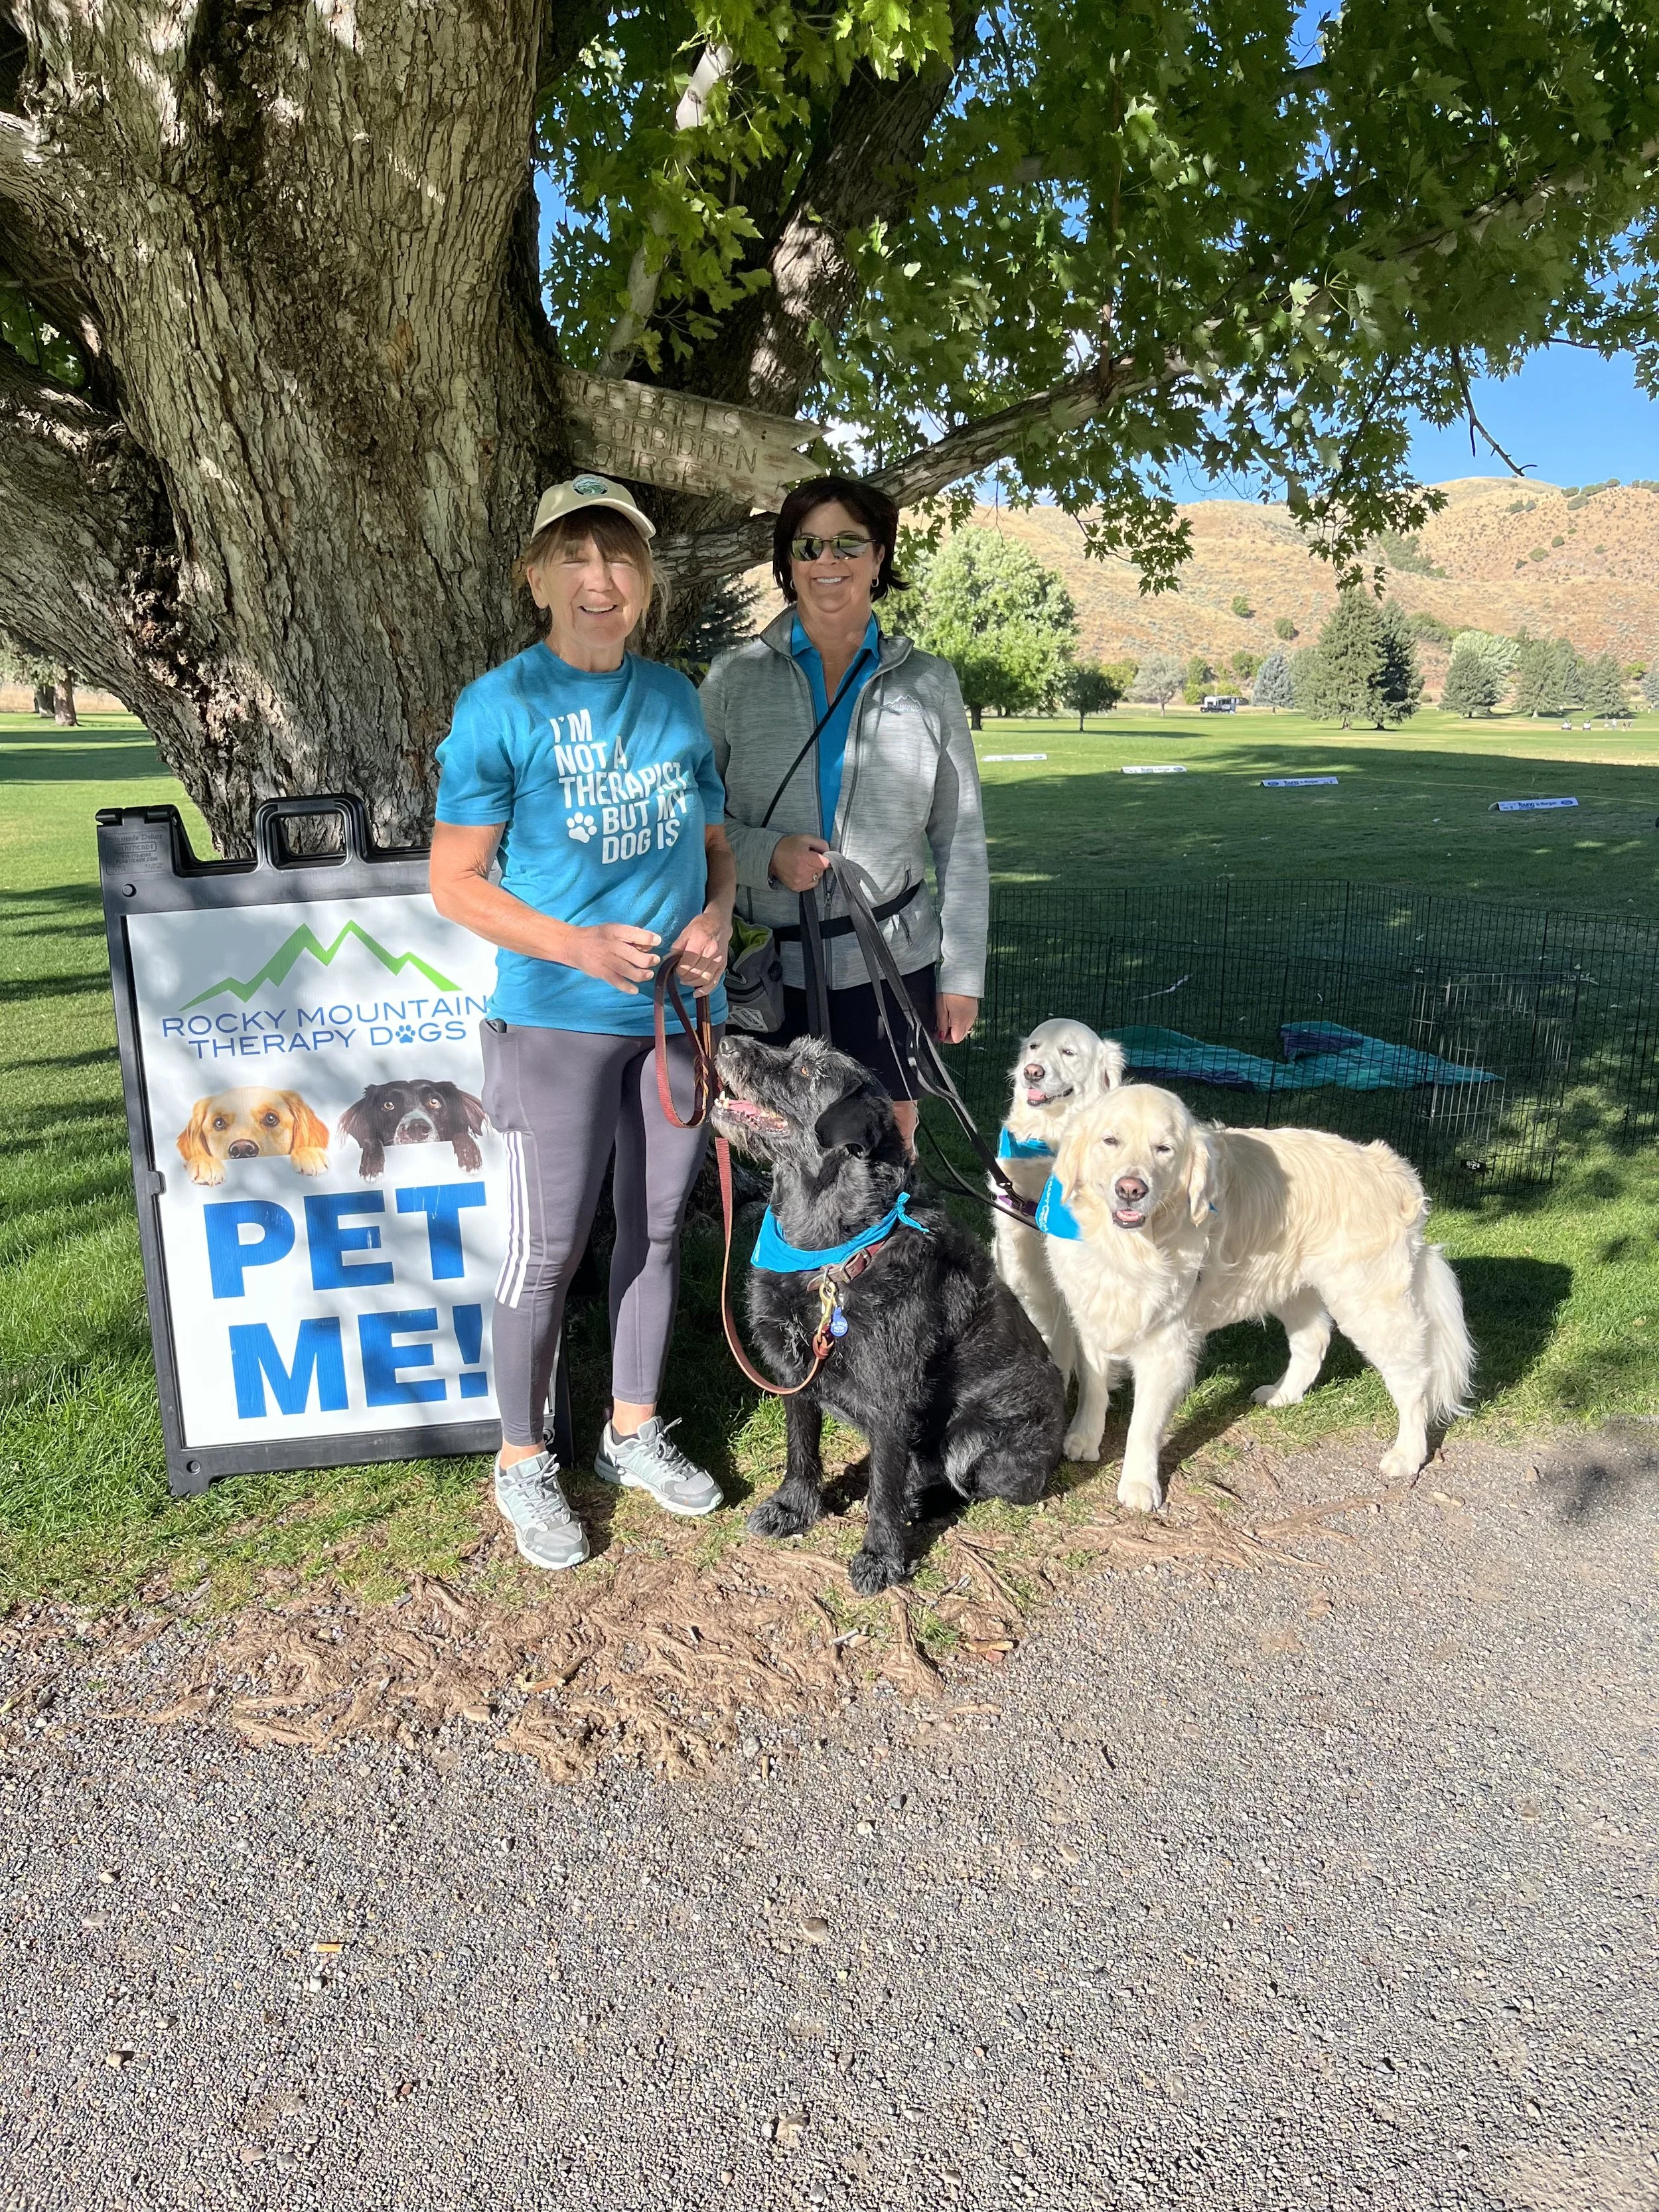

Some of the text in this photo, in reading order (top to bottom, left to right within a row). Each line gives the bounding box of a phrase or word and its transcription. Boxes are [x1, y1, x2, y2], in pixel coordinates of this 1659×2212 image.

[637, 389, 742, 439] BALLS
[571, 438, 703, 488] COURSE
[591, 410, 758, 475] FORBIDDEN
[549, 708, 593, 743] I'M
[553, 735, 628, 776] NOT A
[558, 761, 687, 809] THERAPIST
[602, 790, 687, 836] BUT MY
[602, 819, 681, 865] DOG IS
[162, 995, 488, 1039] ROCKY MOUNTAIN
[187, 1028, 357, 1061] THERAPY
[203, 1181, 487, 1299] PET
[228, 1303, 488, 1420] ME!
